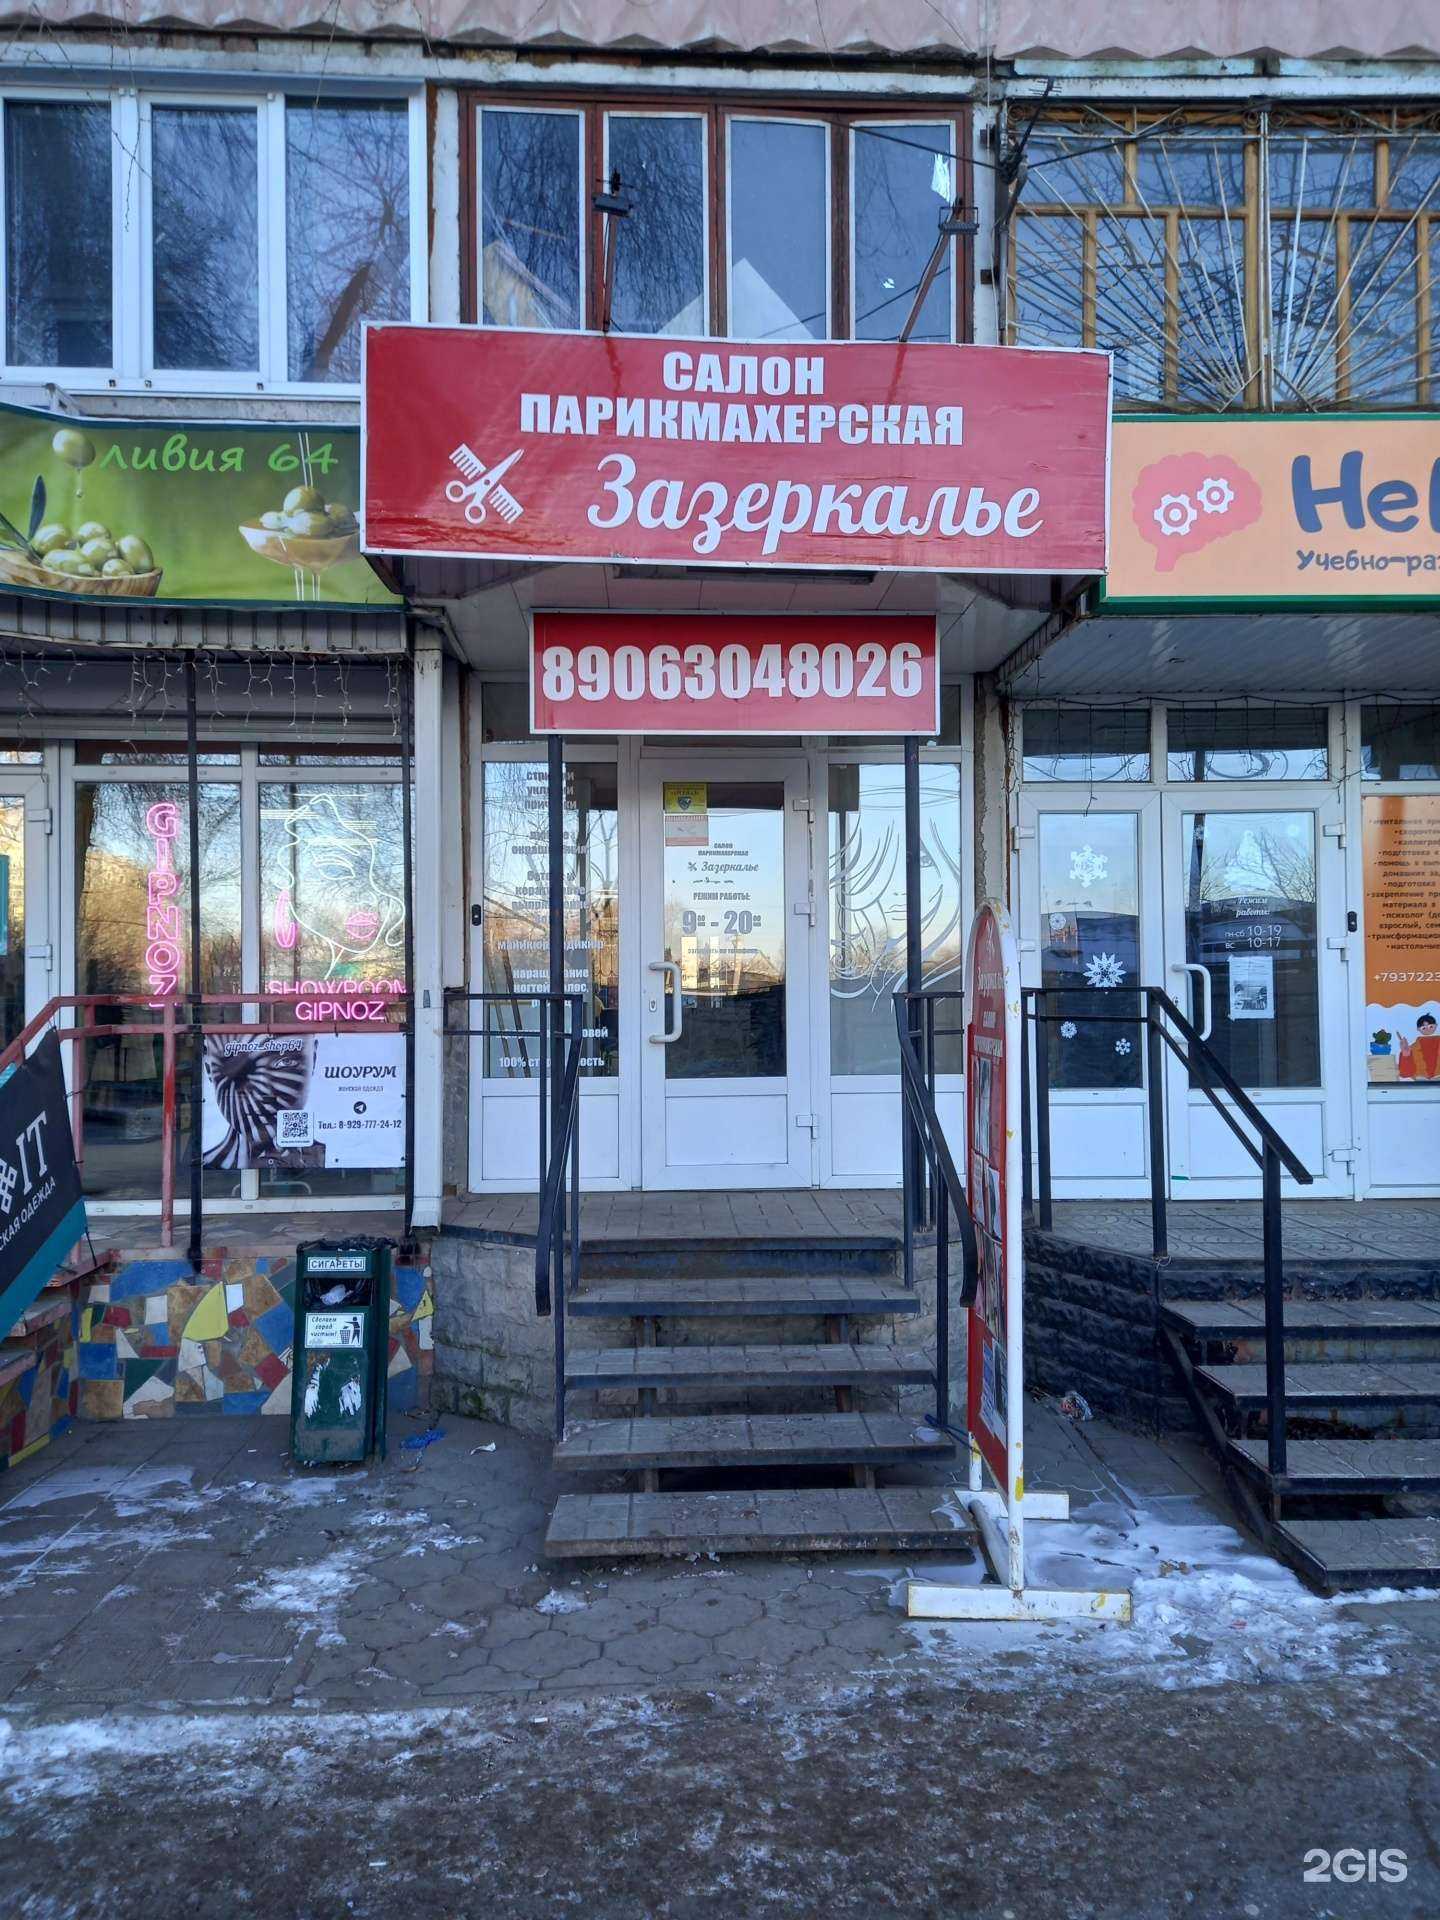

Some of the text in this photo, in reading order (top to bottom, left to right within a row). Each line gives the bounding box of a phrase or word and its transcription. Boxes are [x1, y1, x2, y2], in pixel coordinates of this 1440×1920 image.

[662, 351, 826, 397] САЛОН
[520, 393, 964, 447] ПАРИКМАХЕРСКАЯ
[267, 442, 339, 474] 64
[586, 453, 1044, 557] Зазеркалье
[1291, 450, 1440, 533] Не
[541, 641, 923, 702] 89063048026
[144, 803, 181, 1007] GIPNOZ
[1247, 925, 1282, 937] 10-19
[1247, 937, 1281, 949] 10-17
[295, 1001, 386, 1021] GIPNOZ
[324, 1065, 397, 1079] ШОУРУМ
[499, 1057, 528, 1068] 100%
[338, 1120, 402, 1129] 8-929-777-24-12
[21, 1176, 56, 1223] ОДЕЖДА
[311, 1260, 363, 1268] СИГАРЕТЫ
